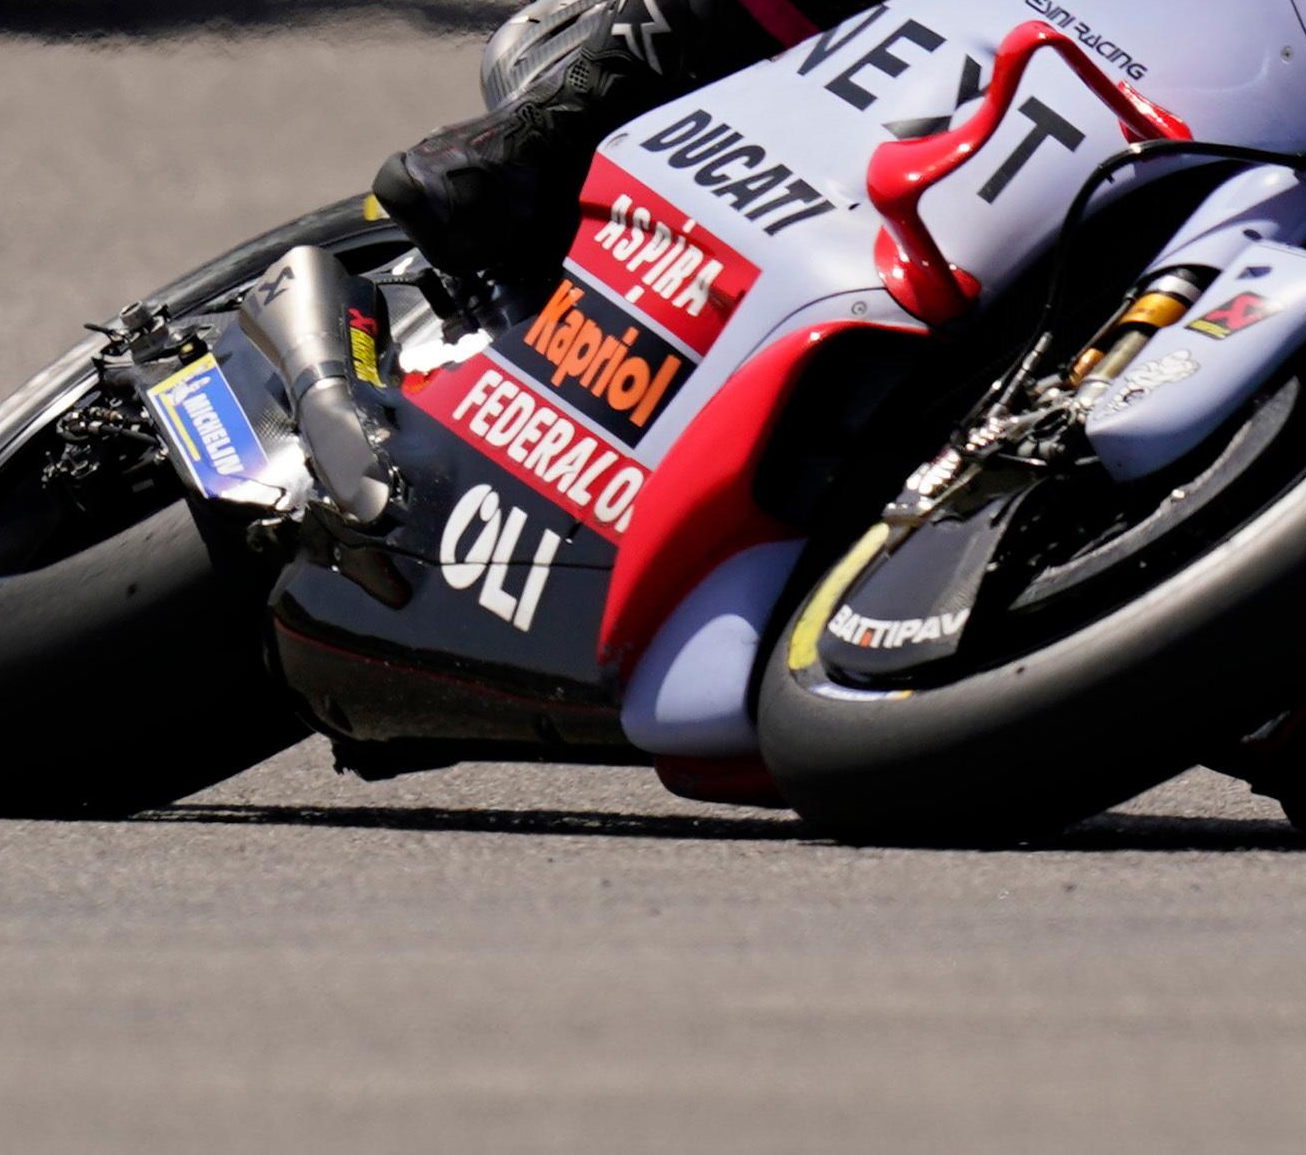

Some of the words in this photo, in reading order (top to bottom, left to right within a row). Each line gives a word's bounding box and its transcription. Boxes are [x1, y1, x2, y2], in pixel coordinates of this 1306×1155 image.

[1073, 21, 1148, 81] RACING
[640, 109, 837, 237] DUCATI
[593, 194, 725, 317] ASPIRA
[523, 278, 682, 428] Kapriol
[183, 393, 245, 475] MICHELIN
[452, 370, 601, 507] FEDERAL
[440, 484, 561, 633] OLI
[828, 604, 971, 648] BATTIPAV
